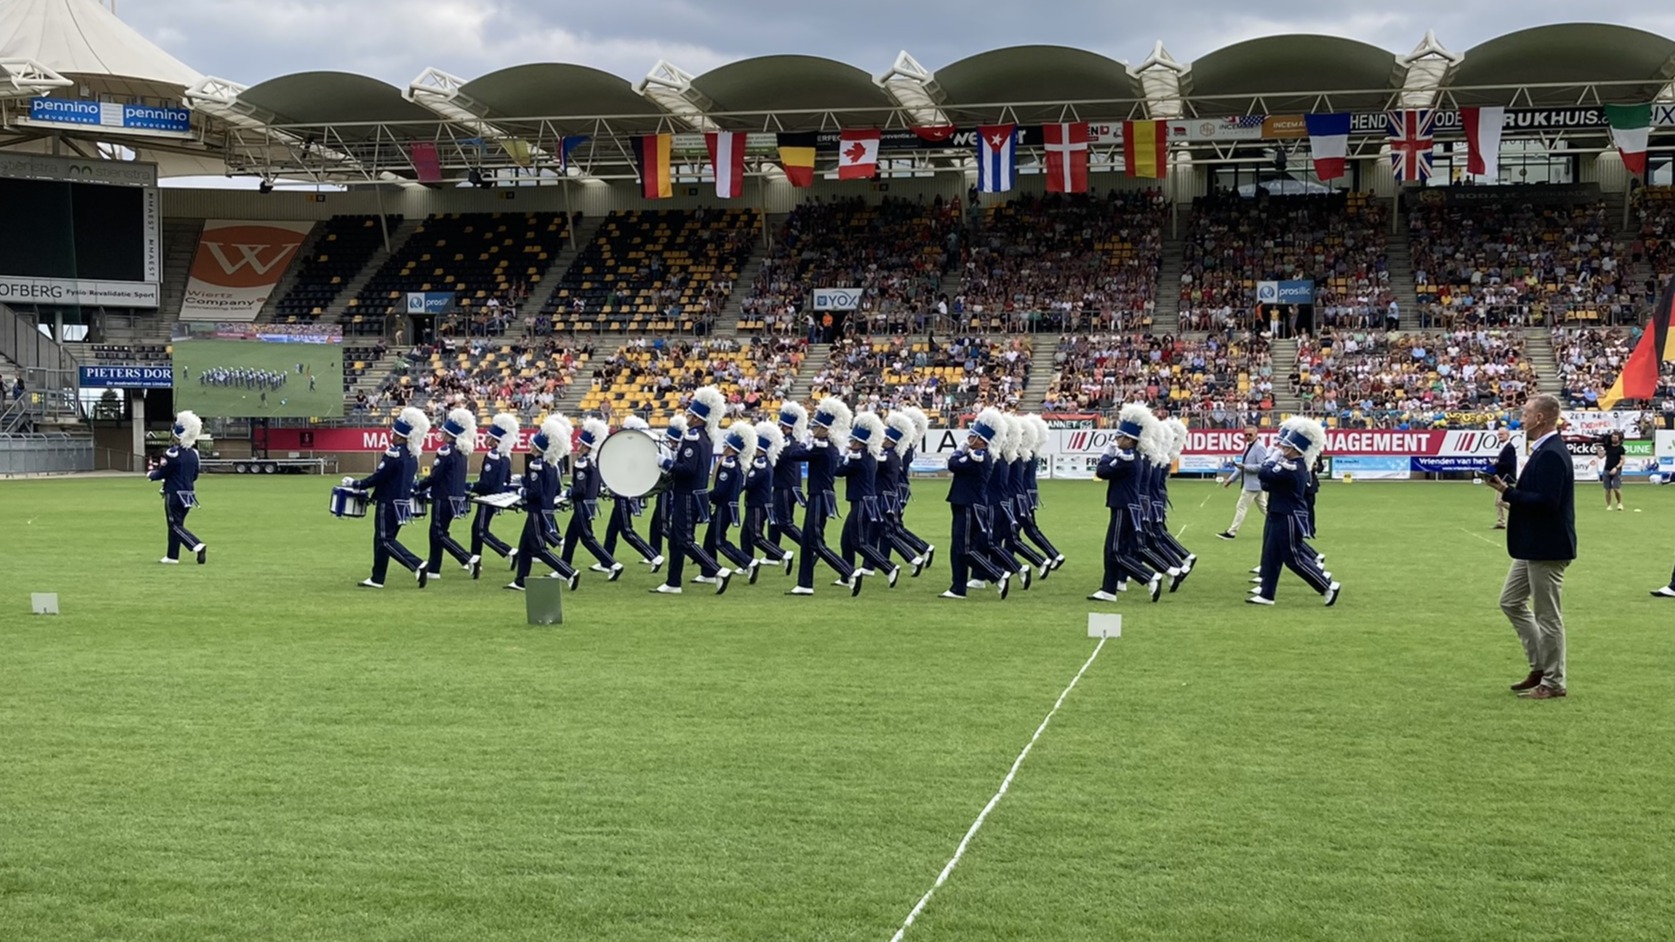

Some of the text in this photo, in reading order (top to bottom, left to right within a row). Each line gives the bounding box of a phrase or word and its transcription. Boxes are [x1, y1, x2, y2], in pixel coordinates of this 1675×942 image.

[33, 99, 98, 114] pennino
[38, 113, 94, 123] advocaten
[125, 107, 188, 121] pennino
[1503, 110, 1609, 127] RUKHUIS.
[130, 121, 184, 130] advocaten
[95, 166, 150, 180] stienstra
[66, 288, 87, 296] Fysio
[89, 289, 132, 298] Revalidatie
[133, 291, 155, 299] Sport
[187, 289, 233, 299] Wiertz
[185, 296, 255, 306] Company
[86, 367, 173, 379] PIETERS DOR
[1419, 457, 1456, 466] Vrienden
[1456, 458, 1472, 466] van
[1472, 457, 1487, 466] het
